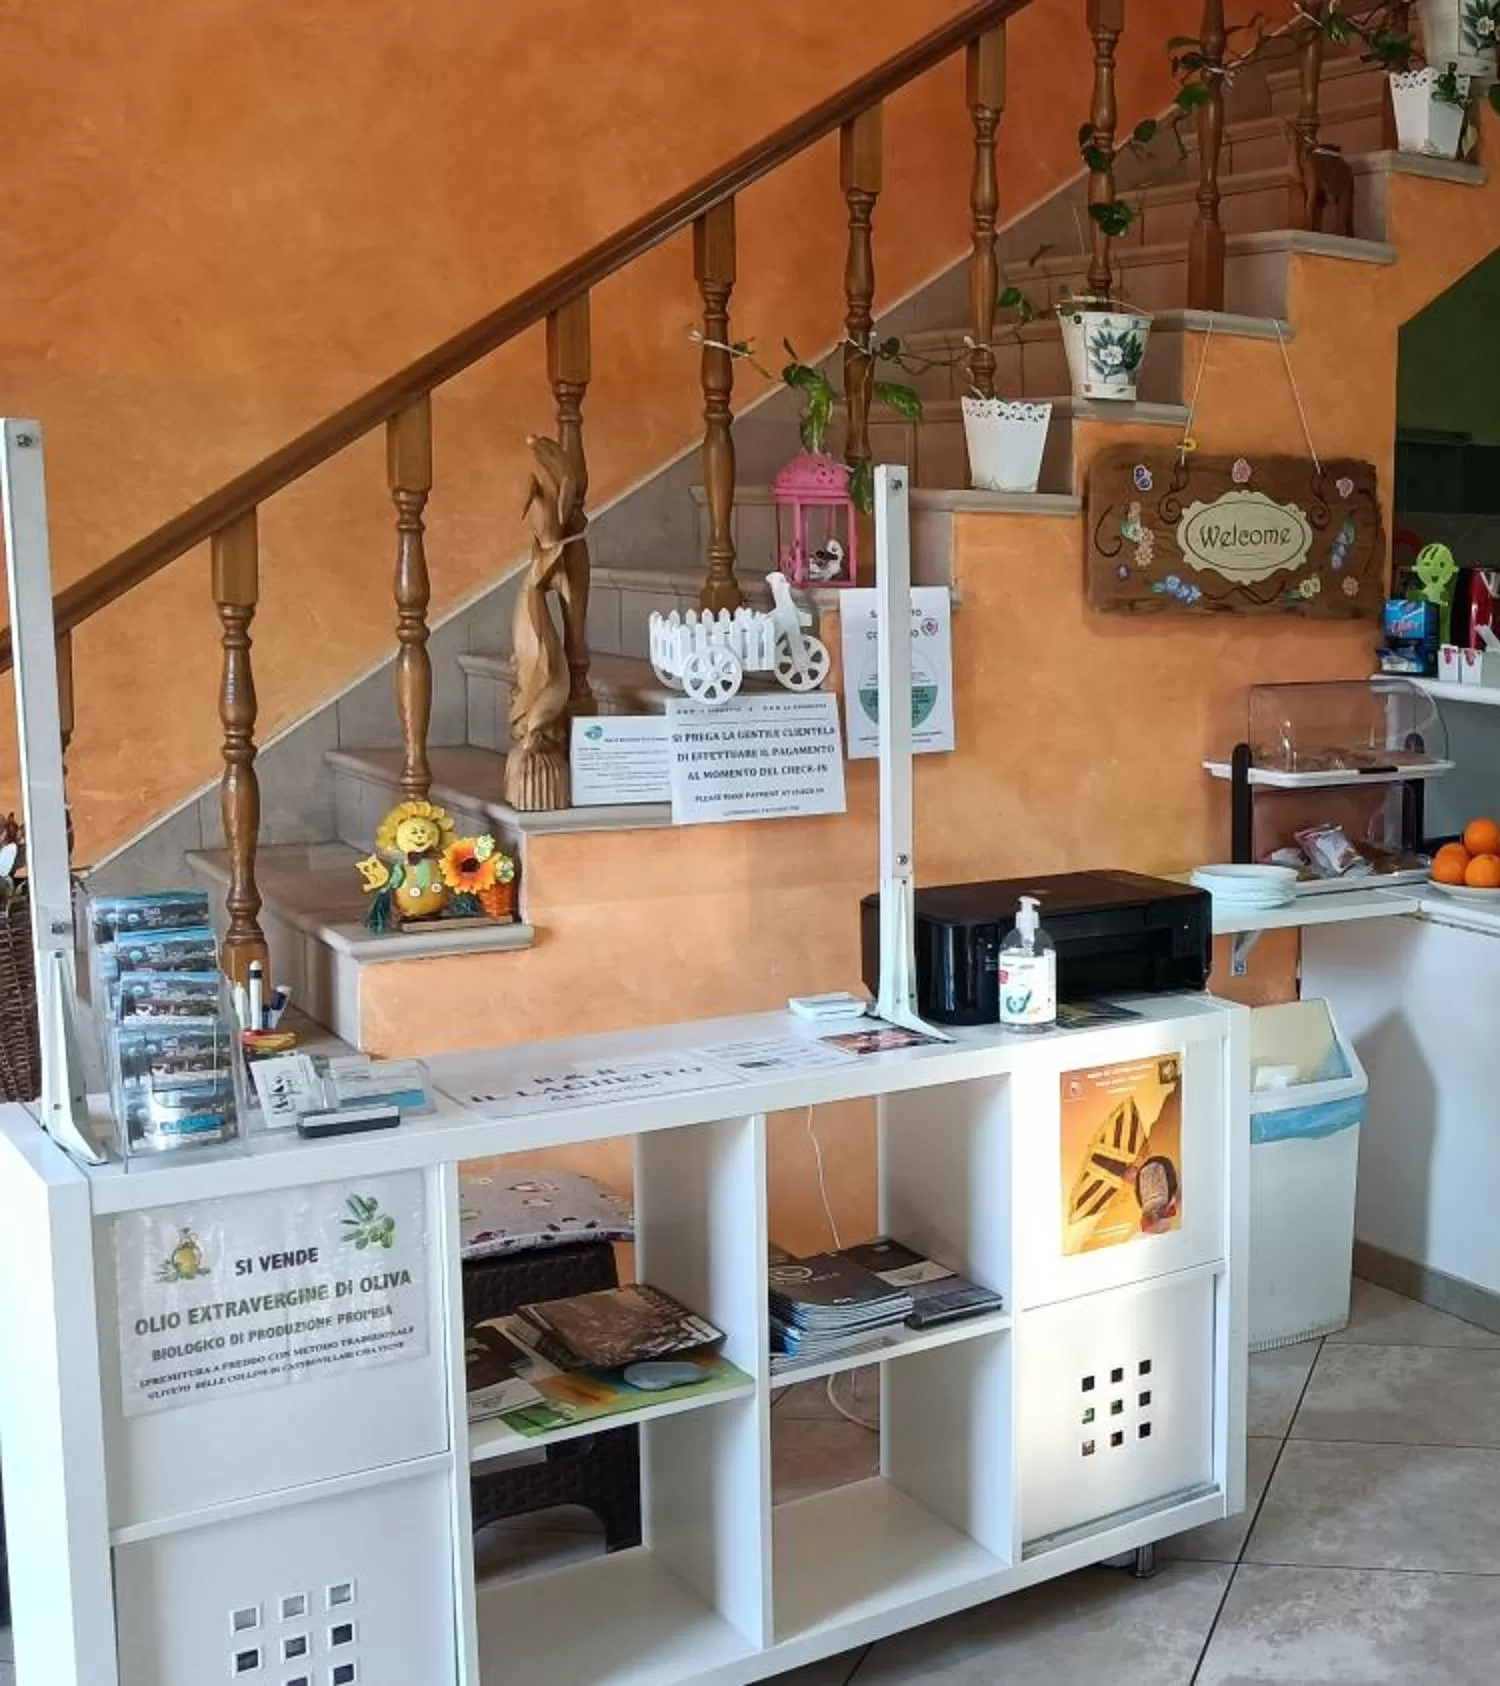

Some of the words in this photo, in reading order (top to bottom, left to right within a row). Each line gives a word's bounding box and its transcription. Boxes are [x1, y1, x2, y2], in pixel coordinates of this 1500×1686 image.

[1199, 523, 1292, 549] Welcome
[722, 731, 736, 742] LA
[677, 753, 689, 763] DI
[771, 744, 836, 757] PAGAMENTO
[687, 771, 701, 781] AL
[703, 767, 758, 780] MOMENTO
[759, 766, 779, 777] DEL
[235, 1257, 254, 1276] SI
[259, 1247, 319, 1272] VENDE
[134, 1311, 181, 1336] OLIO
[188, 1284, 329, 1325] EXTRAVERGINE
[335, 1280, 353, 1299] DI
[360, 1269, 412, 1294] OLIVA
[152, 1337, 225, 1362] BIOLOGICO
[230, 1332, 245, 1345] DI
[249, 1315, 333, 1344] PRODUZIONE
[337, 1304, 393, 1325] PROPRIA
[293, 1341, 339, 1356] METODO
